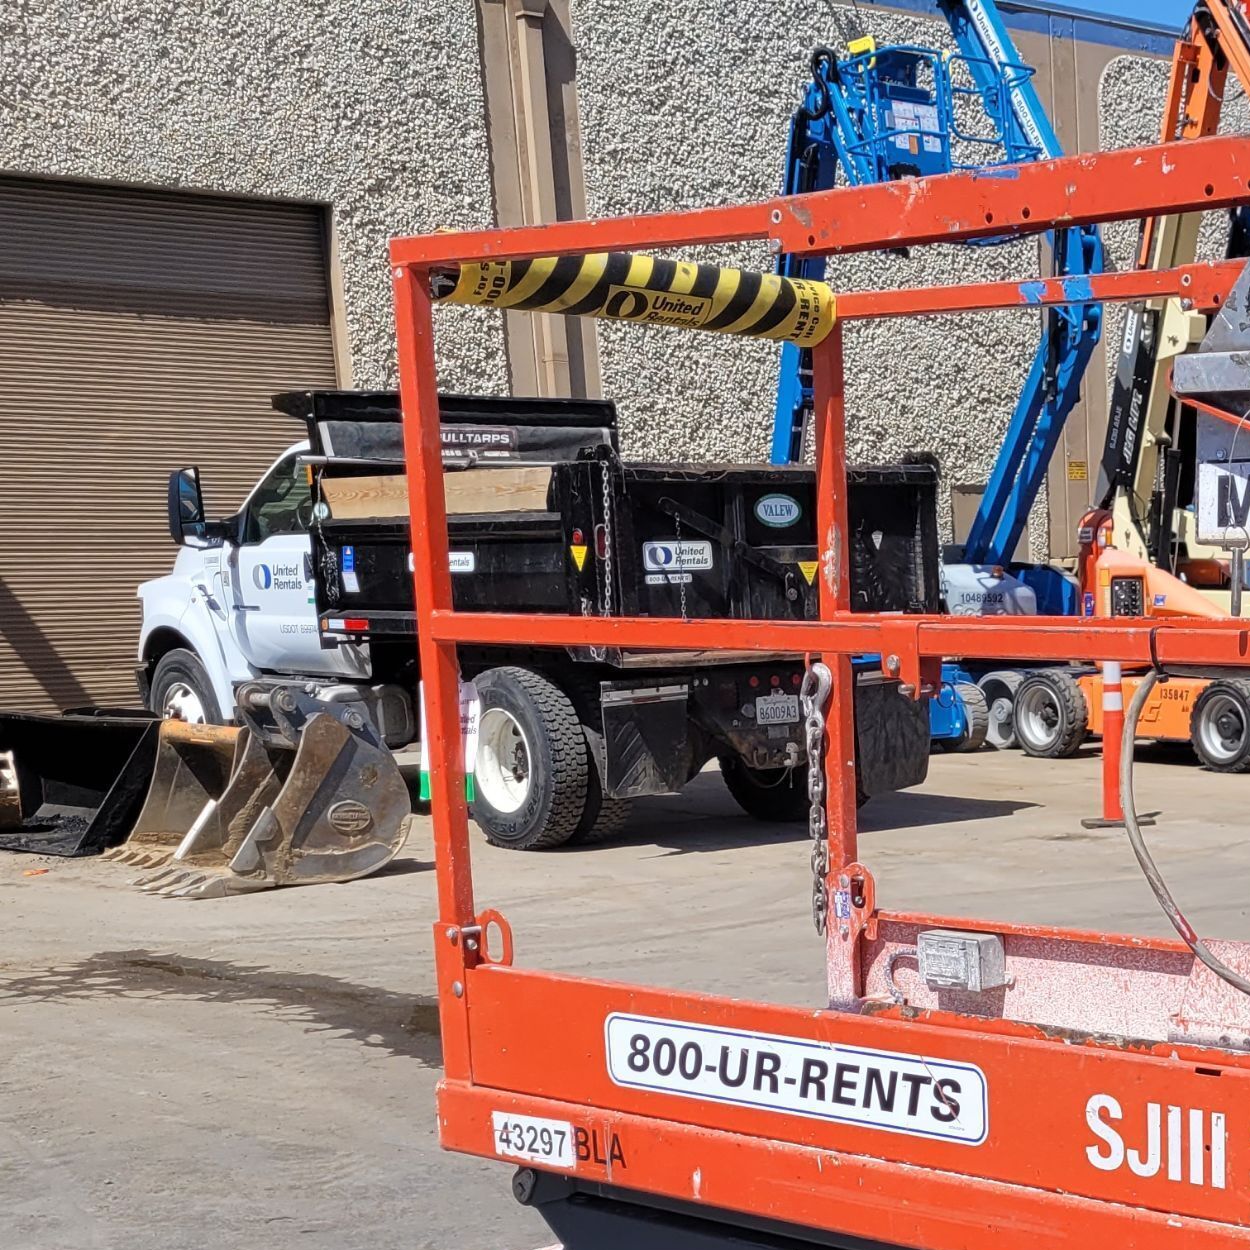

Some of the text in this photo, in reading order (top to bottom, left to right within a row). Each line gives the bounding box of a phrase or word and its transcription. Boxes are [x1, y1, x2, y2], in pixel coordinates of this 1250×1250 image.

[976, 13, 997, 50] United
[652, 296, 704, 317] United
[645, 311, 702, 328] Rentals
[440, 433, 510, 445] ULLTARPS
[762, 504, 794, 517] VALEW
[675, 546, 705, 556] United
[449, 557, 470, 567] entals
[675, 556, 709, 566] Rentals
[272, 563, 299, 577] United
[273, 577, 303, 591] Rentals
[760, 705, 797, 720] 86009A3
[626, 1032, 963, 1123] 800-UR-RENTS
[498, 1120, 567, 1159] 43297
